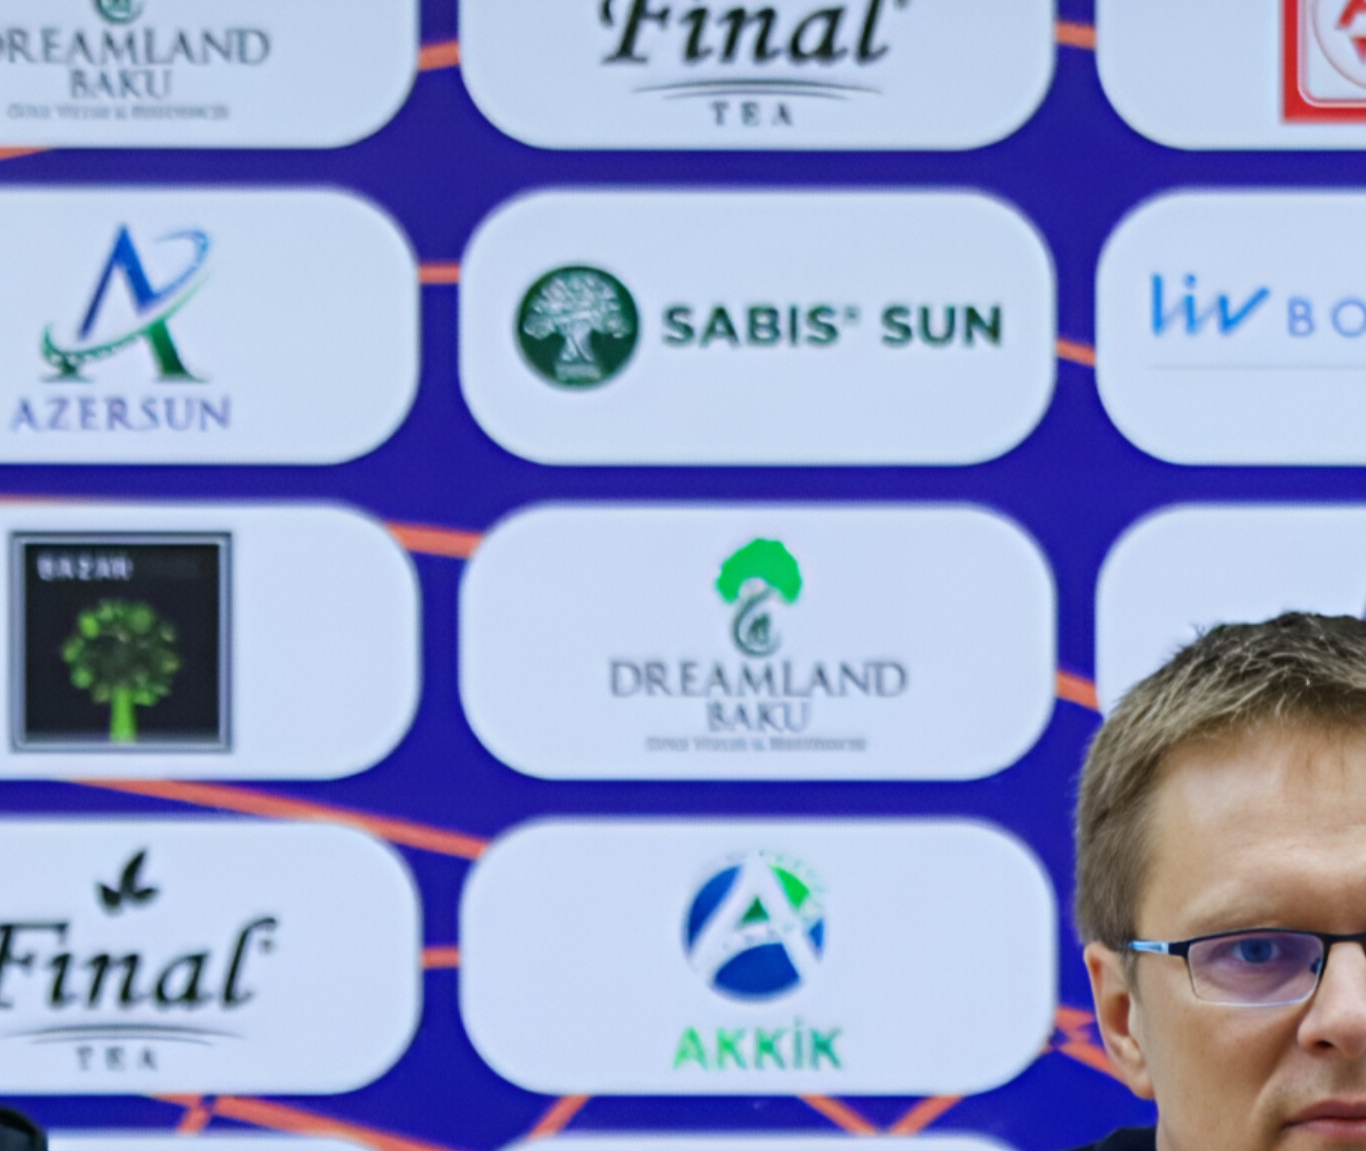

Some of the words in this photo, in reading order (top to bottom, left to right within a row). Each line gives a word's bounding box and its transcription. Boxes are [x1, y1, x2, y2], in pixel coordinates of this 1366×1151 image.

[70, 70, 171, 98] BAKU
[710, 101, 792, 126] TEA
[1150, 272, 1272, 338] liv
[880, 303, 1003, 348] SUN
[12, 396, 230, 431] AZERSUN
[37, 554, 133, 580] BAZAR
[610, 657, 908, 697] DREAMLAND
[707, 701, 807, 731] BAKU
[76, 1045, 156, 1070] TEA
[673, 1018, 843, 1070] AKKİK
